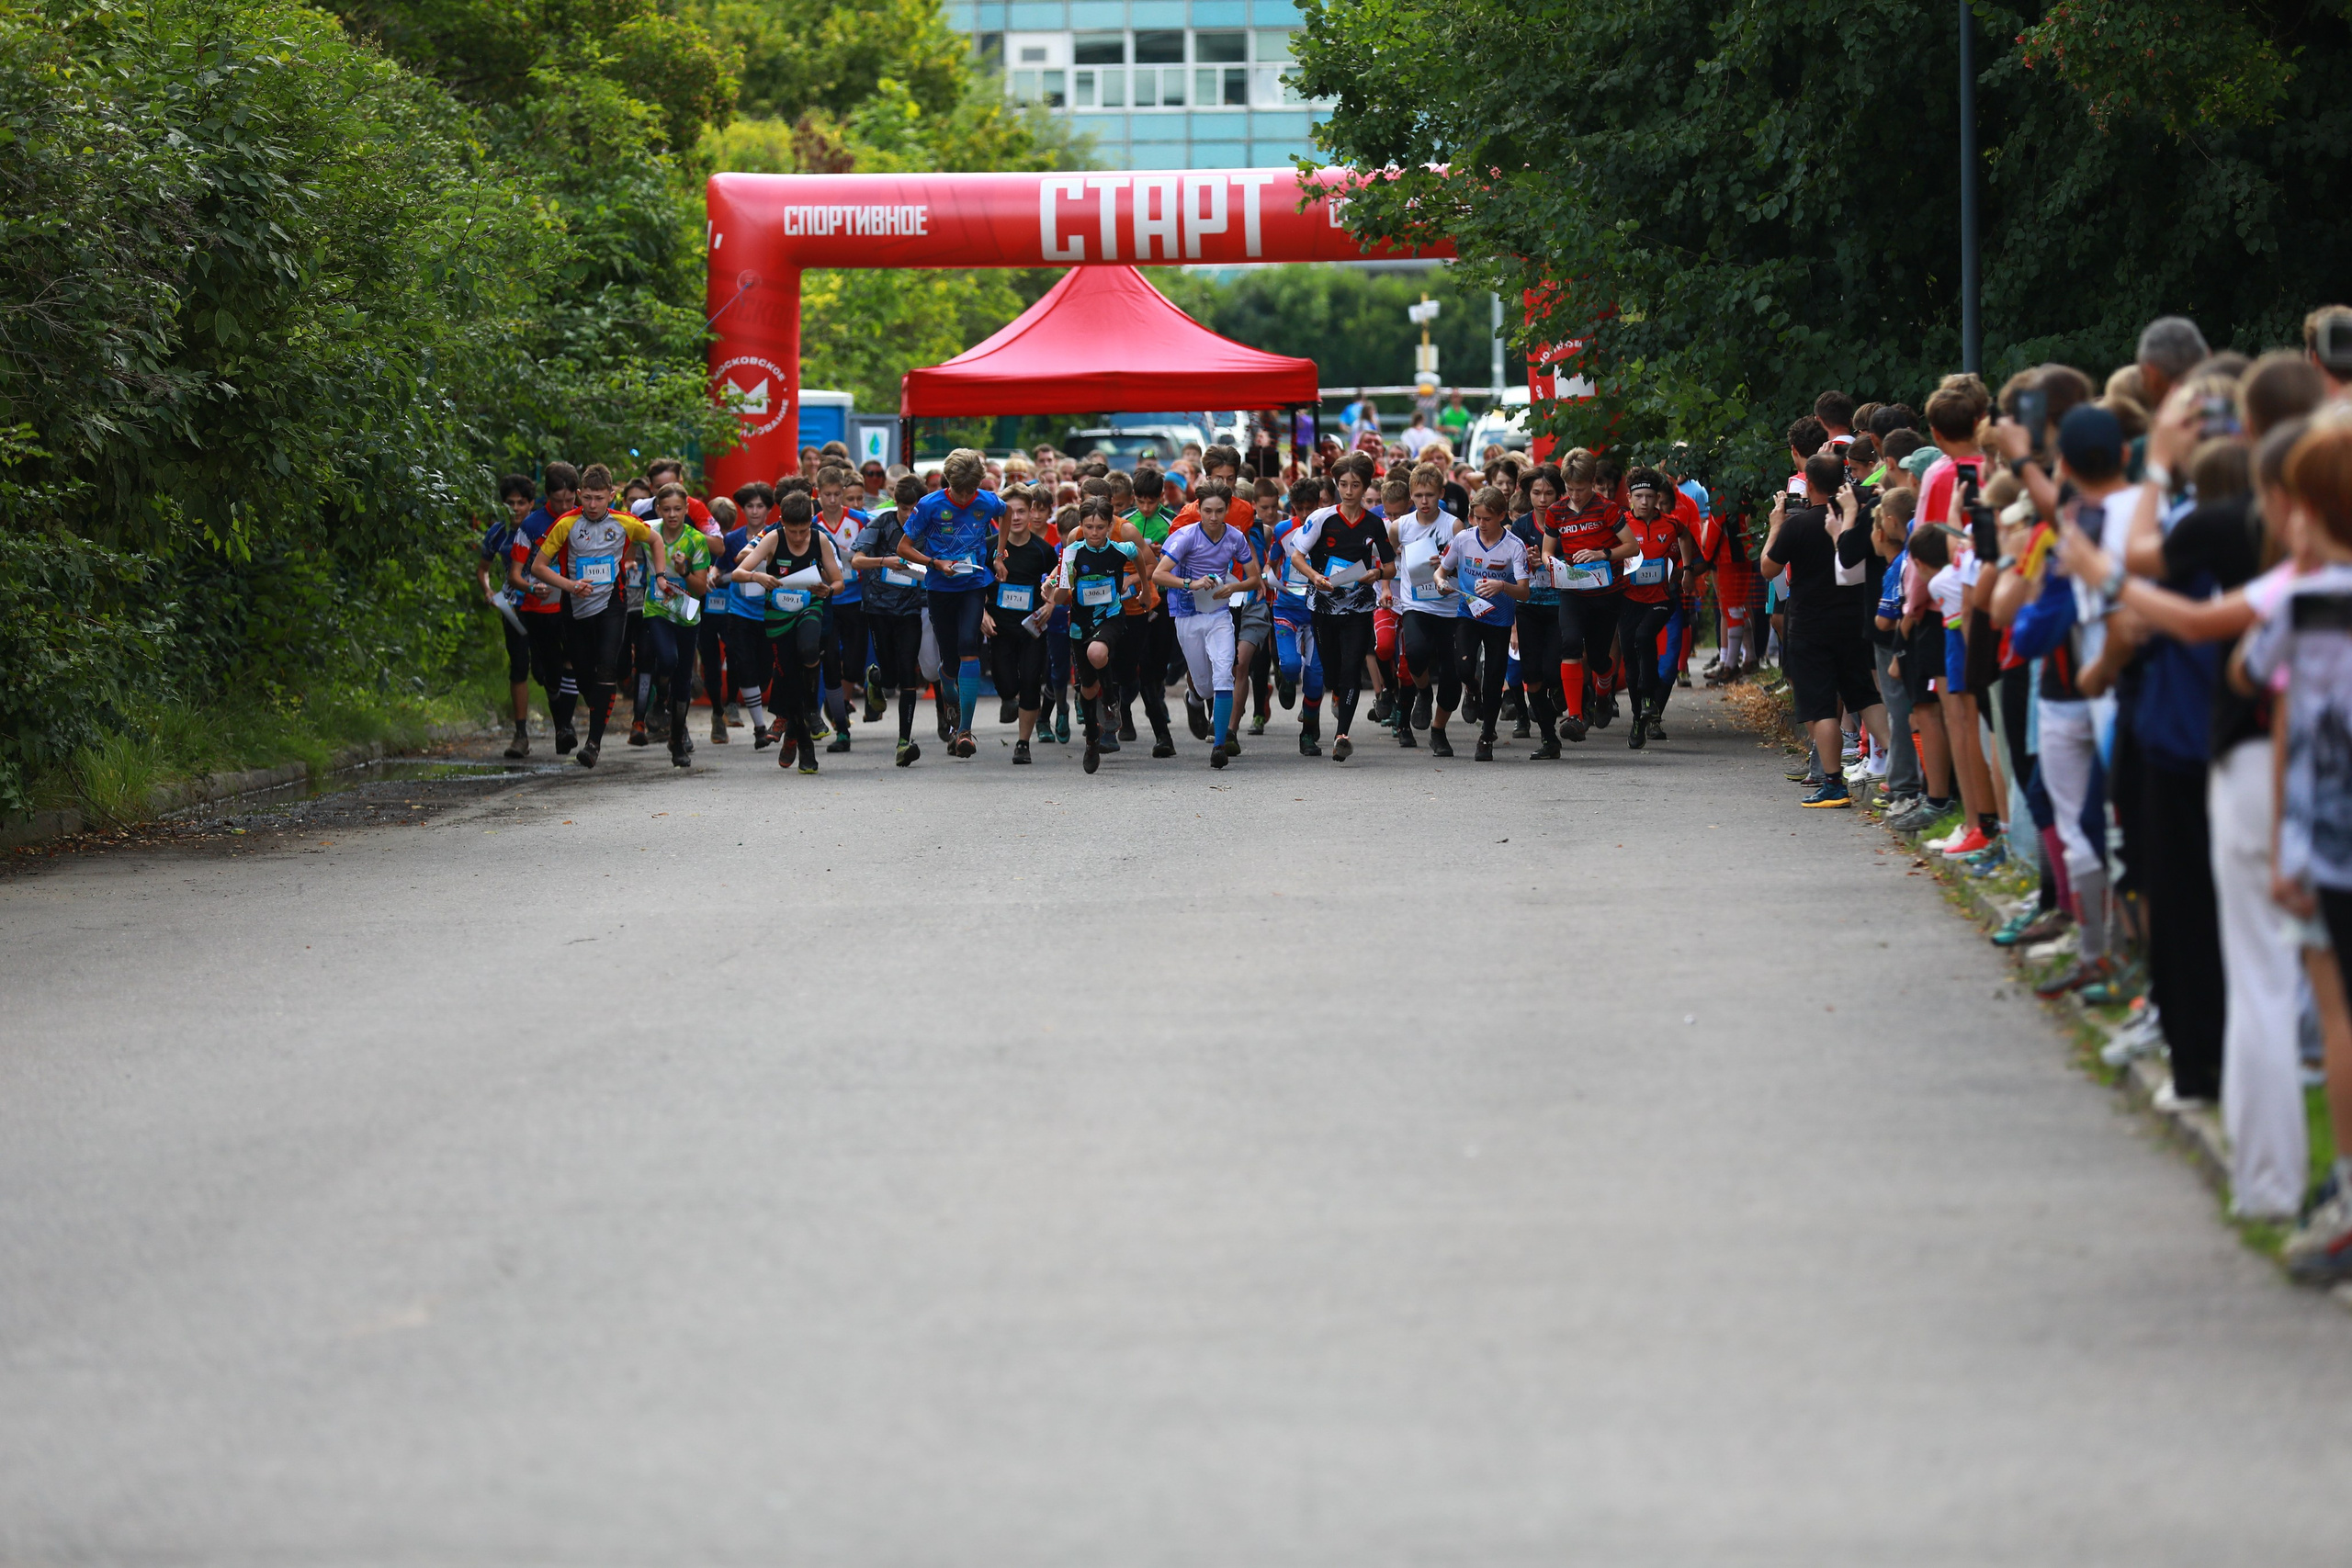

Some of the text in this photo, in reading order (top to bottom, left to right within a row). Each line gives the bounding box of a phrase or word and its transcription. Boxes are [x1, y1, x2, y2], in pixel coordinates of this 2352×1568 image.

[784, 205, 928, 236] СПОРТИВНОЕ
[1040, 175, 1274, 261] СТАРТ
[588, 568, 605, 576] 310.1
[1464, 567, 1507, 579] KUZMOLOVO
[1640, 571, 1658, 580] 321.1
[782, 595, 800, 604] 309.1
[1005, 594, 1023, 603] 317.1
